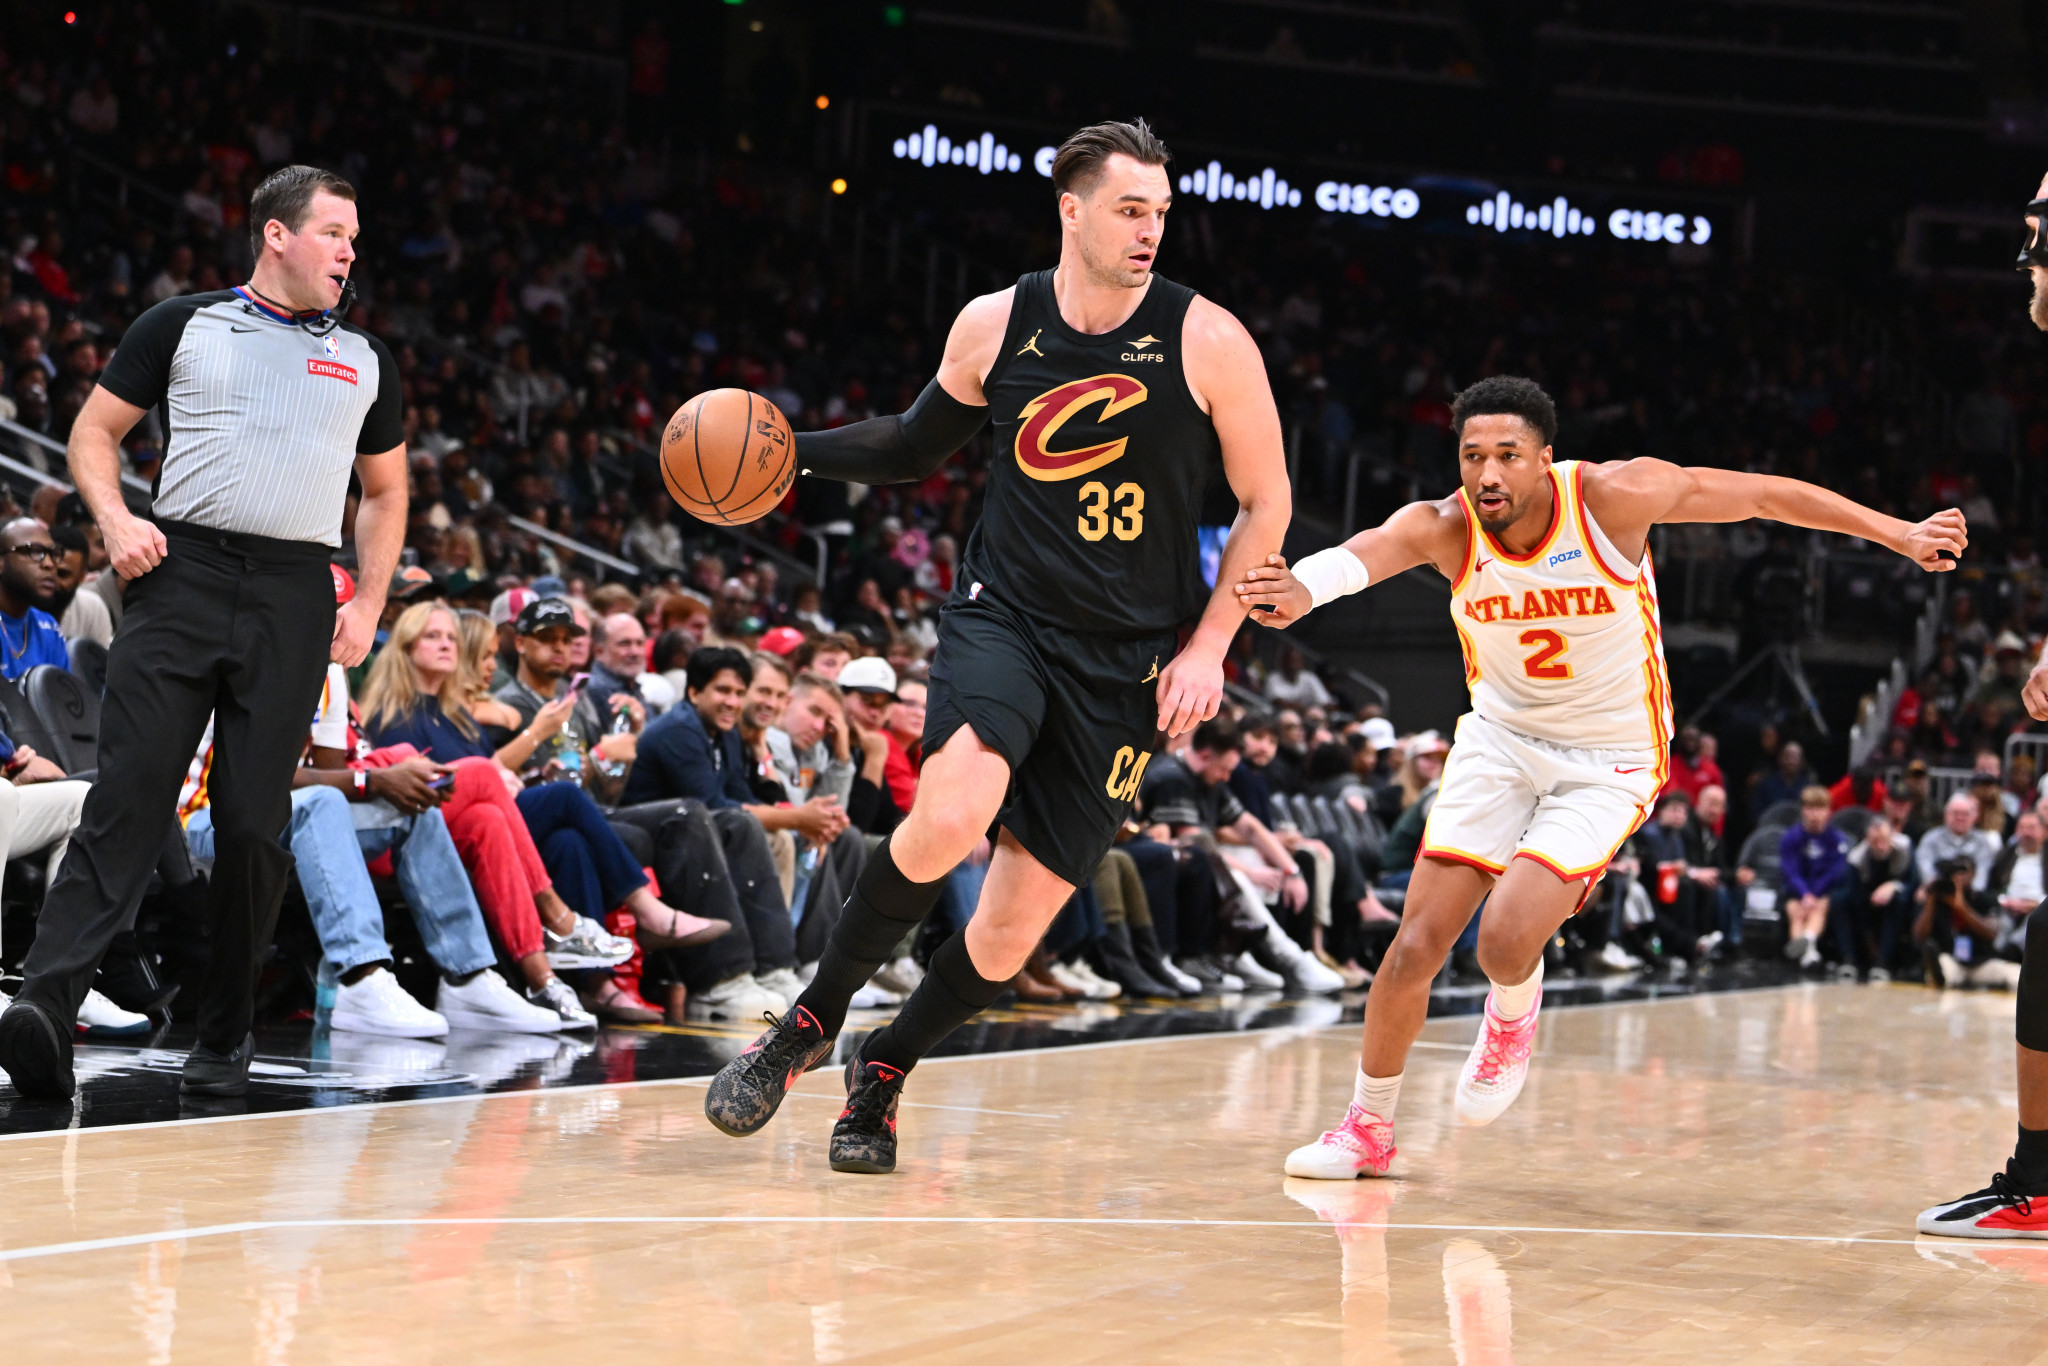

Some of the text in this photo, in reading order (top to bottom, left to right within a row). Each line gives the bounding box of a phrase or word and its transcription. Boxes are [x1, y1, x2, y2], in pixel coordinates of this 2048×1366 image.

[1315, 180, 1420, 220] CISCO
[308, 360, 357, 381] Emirates
[1120, 352, 1165, 363] CLIFFS
[1014, 373, 1149, 482] C
[1078, 481, 1145, 541] 33
[1549, 549, 1582, 567] paze
[1464, 586, 1616, 624] ATLANTA
[1518, 629, 1574, 680] 2
[1105, 745, 1152, 803] CA
